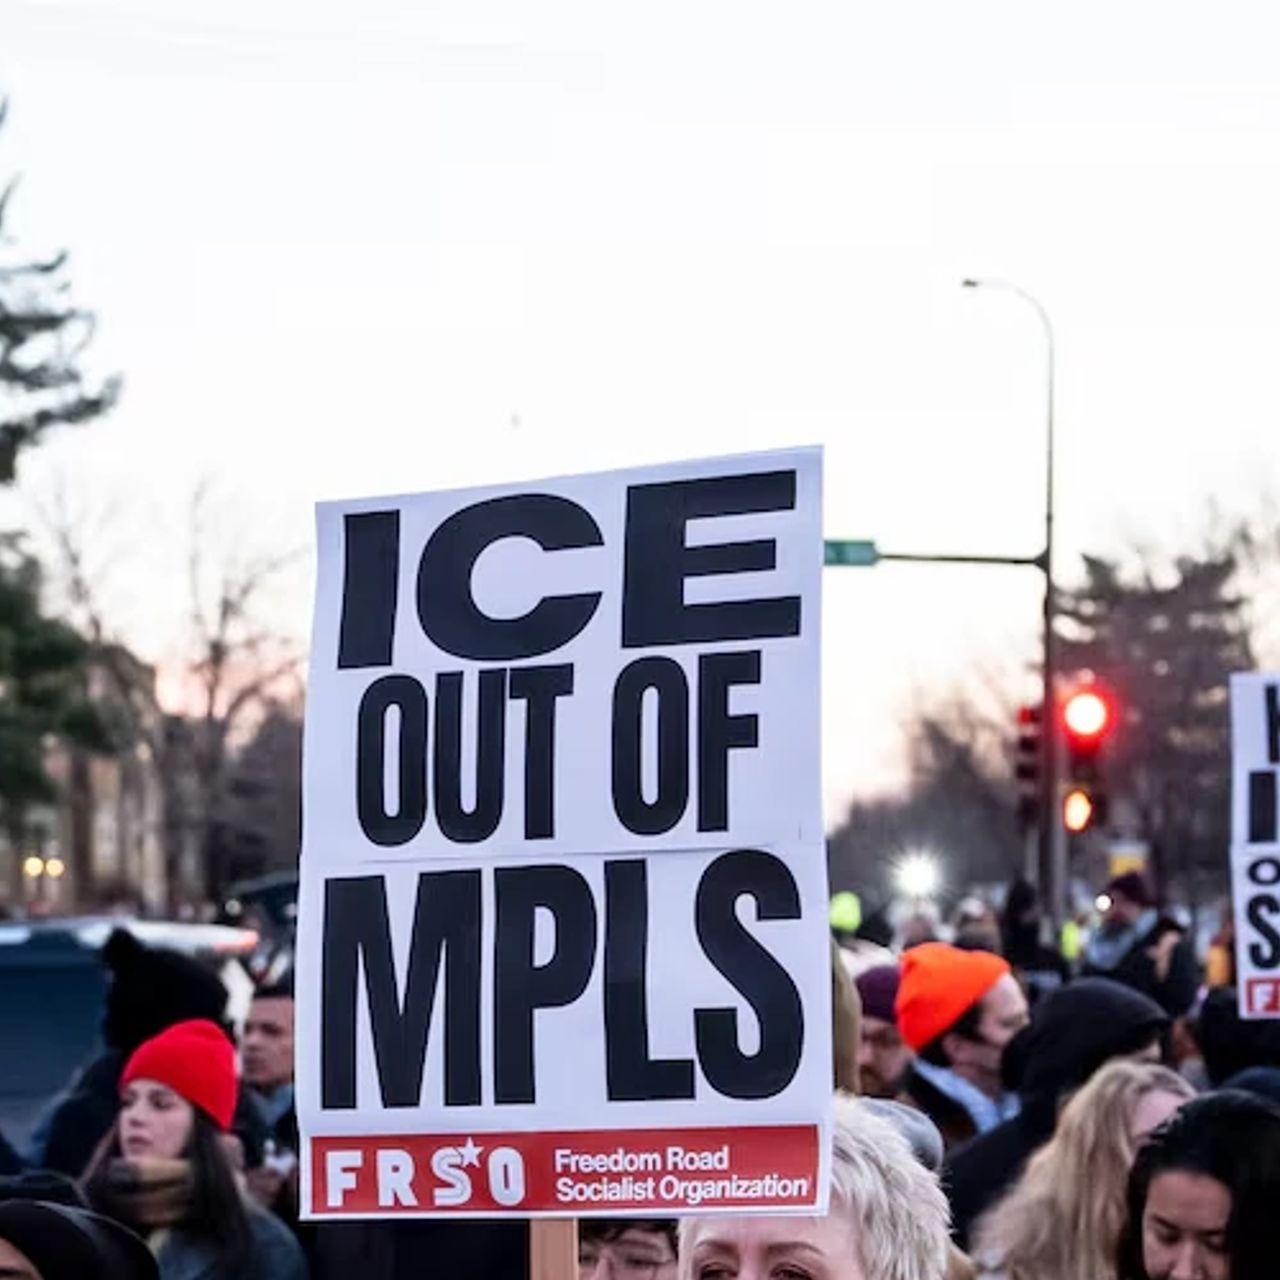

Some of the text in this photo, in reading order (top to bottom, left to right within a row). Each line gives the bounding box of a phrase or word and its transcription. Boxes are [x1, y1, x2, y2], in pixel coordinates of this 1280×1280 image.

[337, 469, 801, 669] ICE
[356, 650, 762, 847] OUT OF
[320, 849, 804, 1111] MPLS
[326, 1146, 525, 1207] FRSO
[555, 1145, 729, 1173] Freedom Road
[556, 1173, 808, 1205] Socialist Organization
